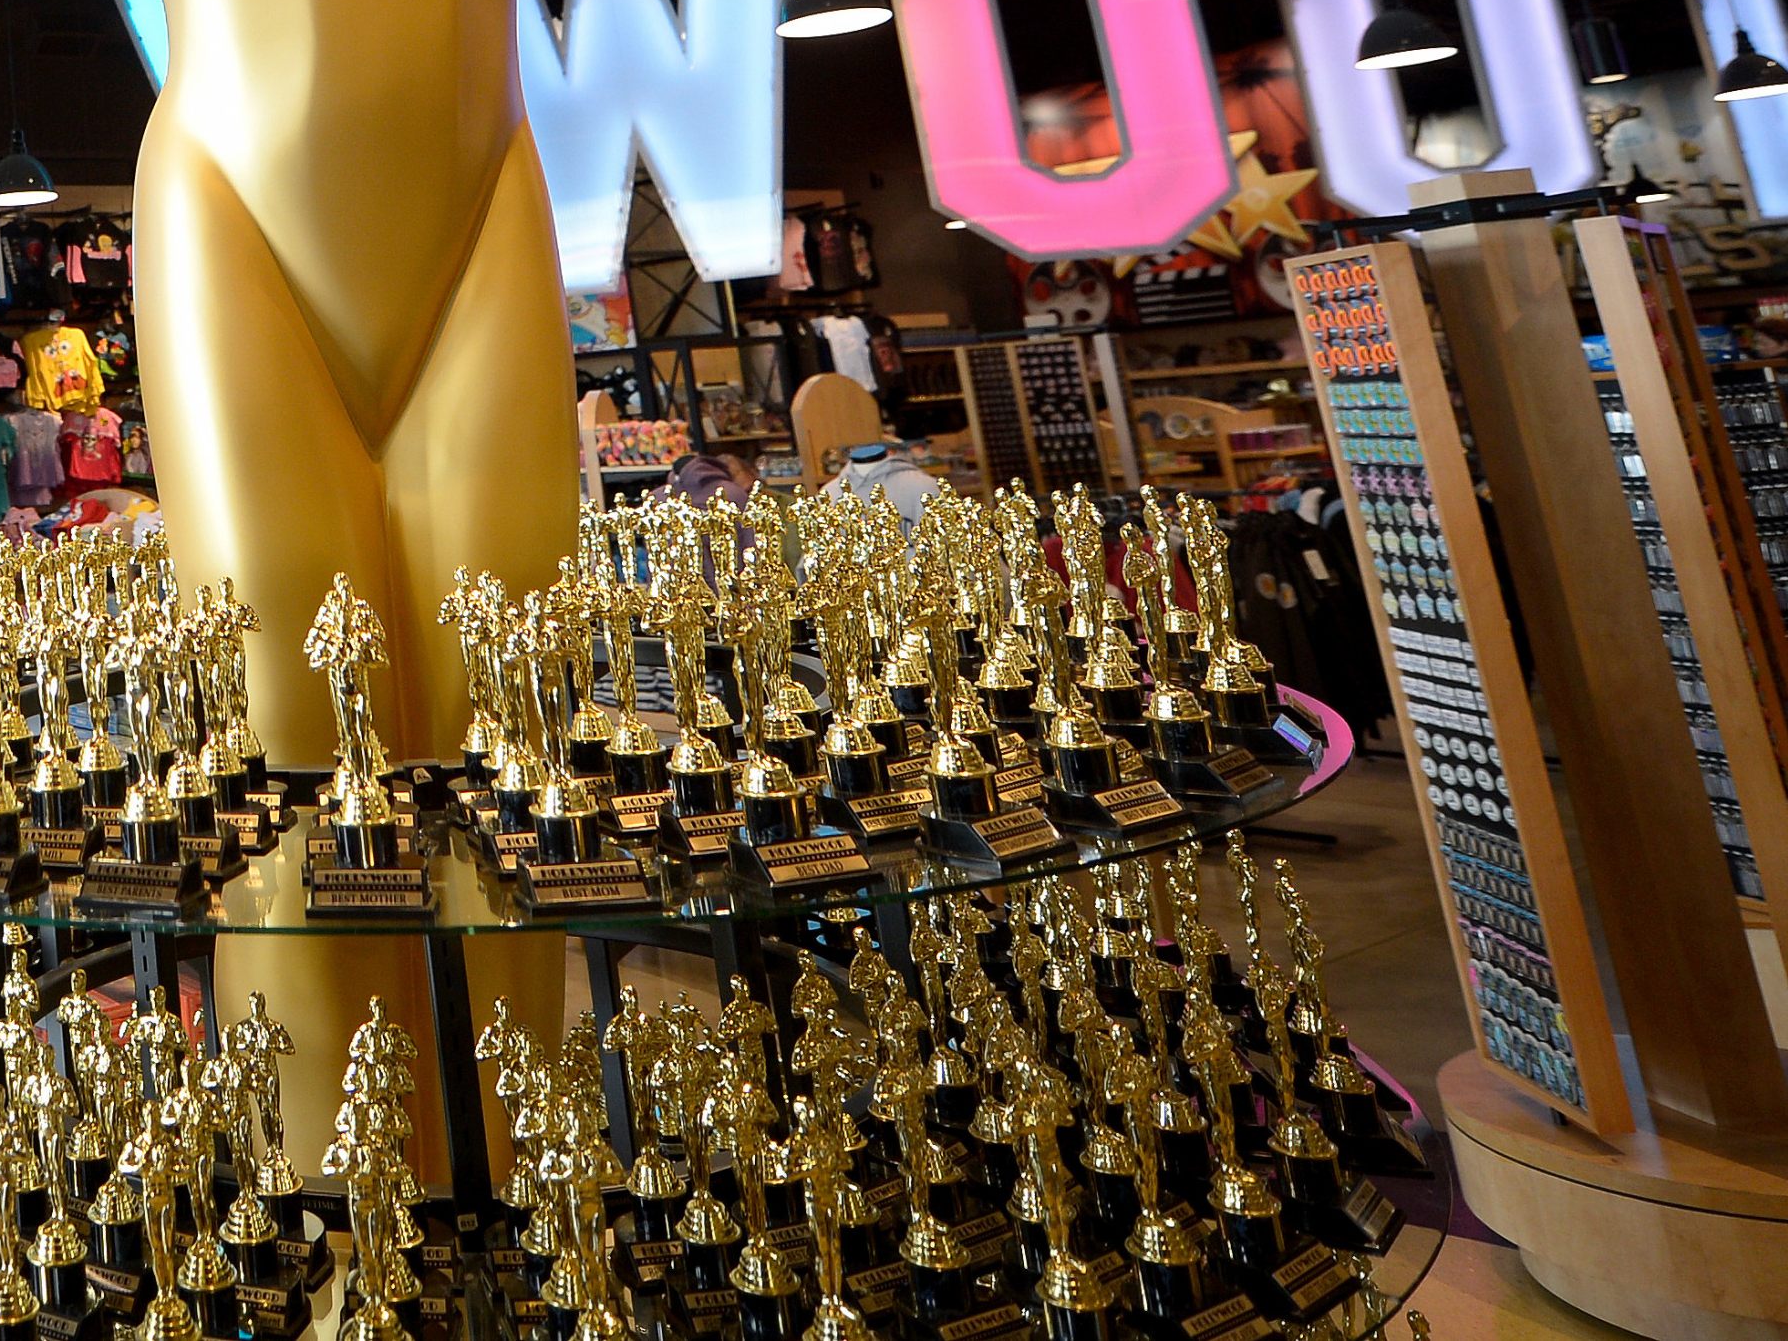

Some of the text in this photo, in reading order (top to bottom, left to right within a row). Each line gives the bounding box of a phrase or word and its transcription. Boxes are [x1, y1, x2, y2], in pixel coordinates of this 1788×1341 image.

[996, 768, 1036, 784] OLLYWOOD
[858, 792, 927, 809] HOLLYWOOD
[1104, 784, 1157, 804] HOLLYWOOD
[621, 795, 675, 808] HOLLYW
[691, 815, 745, 828] HOLLYW
[769, 839, 847, 858] HOLLYWOOD
[97, 864, 173, 878] HOLLYWOOD
[540, 865, 630, 879] HOLLYWOOD
[795, 860, 844, 876] BEST DAD
[324, 873, 412, 883] HOLLYWOOD
[96, 884, 163, 898] BEST PARENTS
[562, 886, 621, 899] BEST MOM
[331, 893, 407, 904] BEST MOTHER
[640, 1241, 682, 1256] HOLLY
[236, 1286, 280, 1303] YWOOD
[695, 1292, 737, 1306] HOLLY
